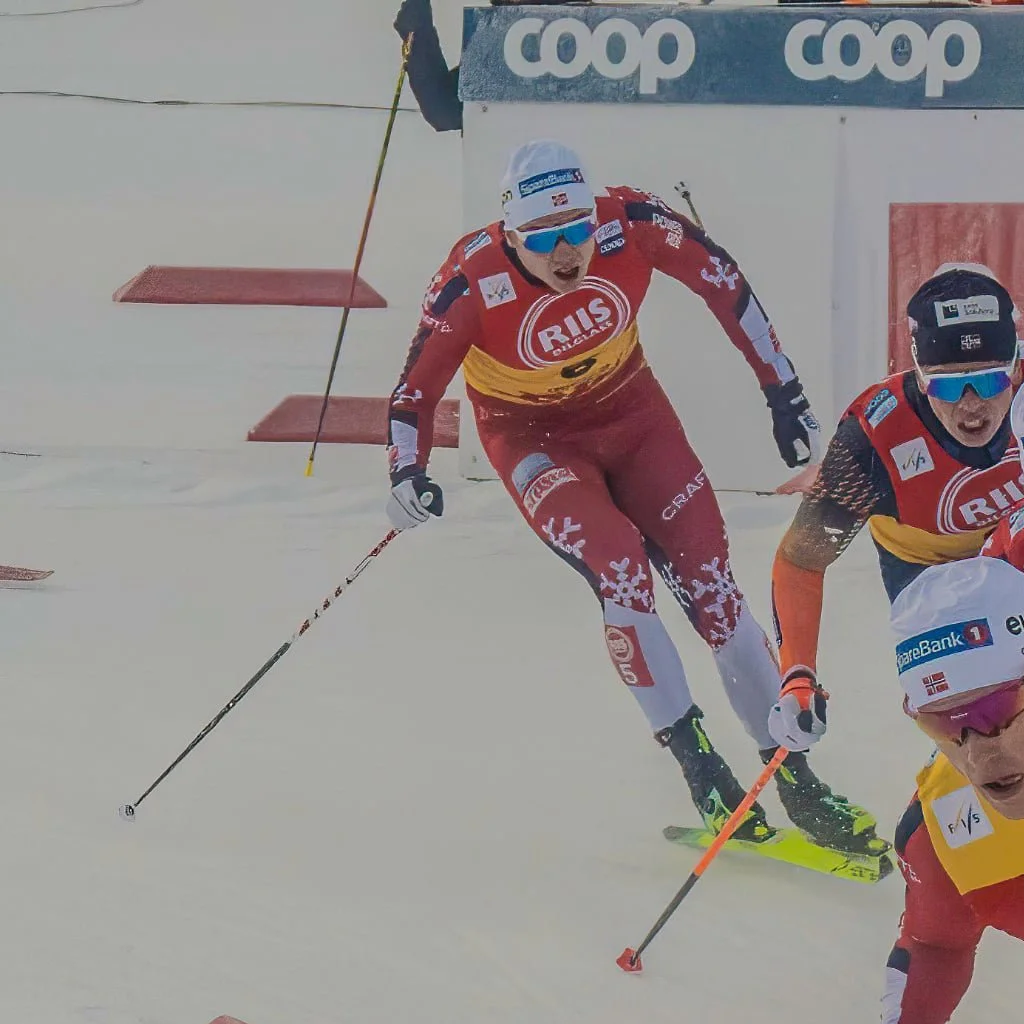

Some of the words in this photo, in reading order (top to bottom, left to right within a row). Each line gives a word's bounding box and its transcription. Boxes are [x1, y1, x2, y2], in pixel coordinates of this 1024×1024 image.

[503, 16, 696, 95] coop
[784, 17, 982, 97] coop
[537, 298, 612, 352] RIIS
[662, 470, 706, 521] CRAF
[897, 631, 964, 671] pareBank
